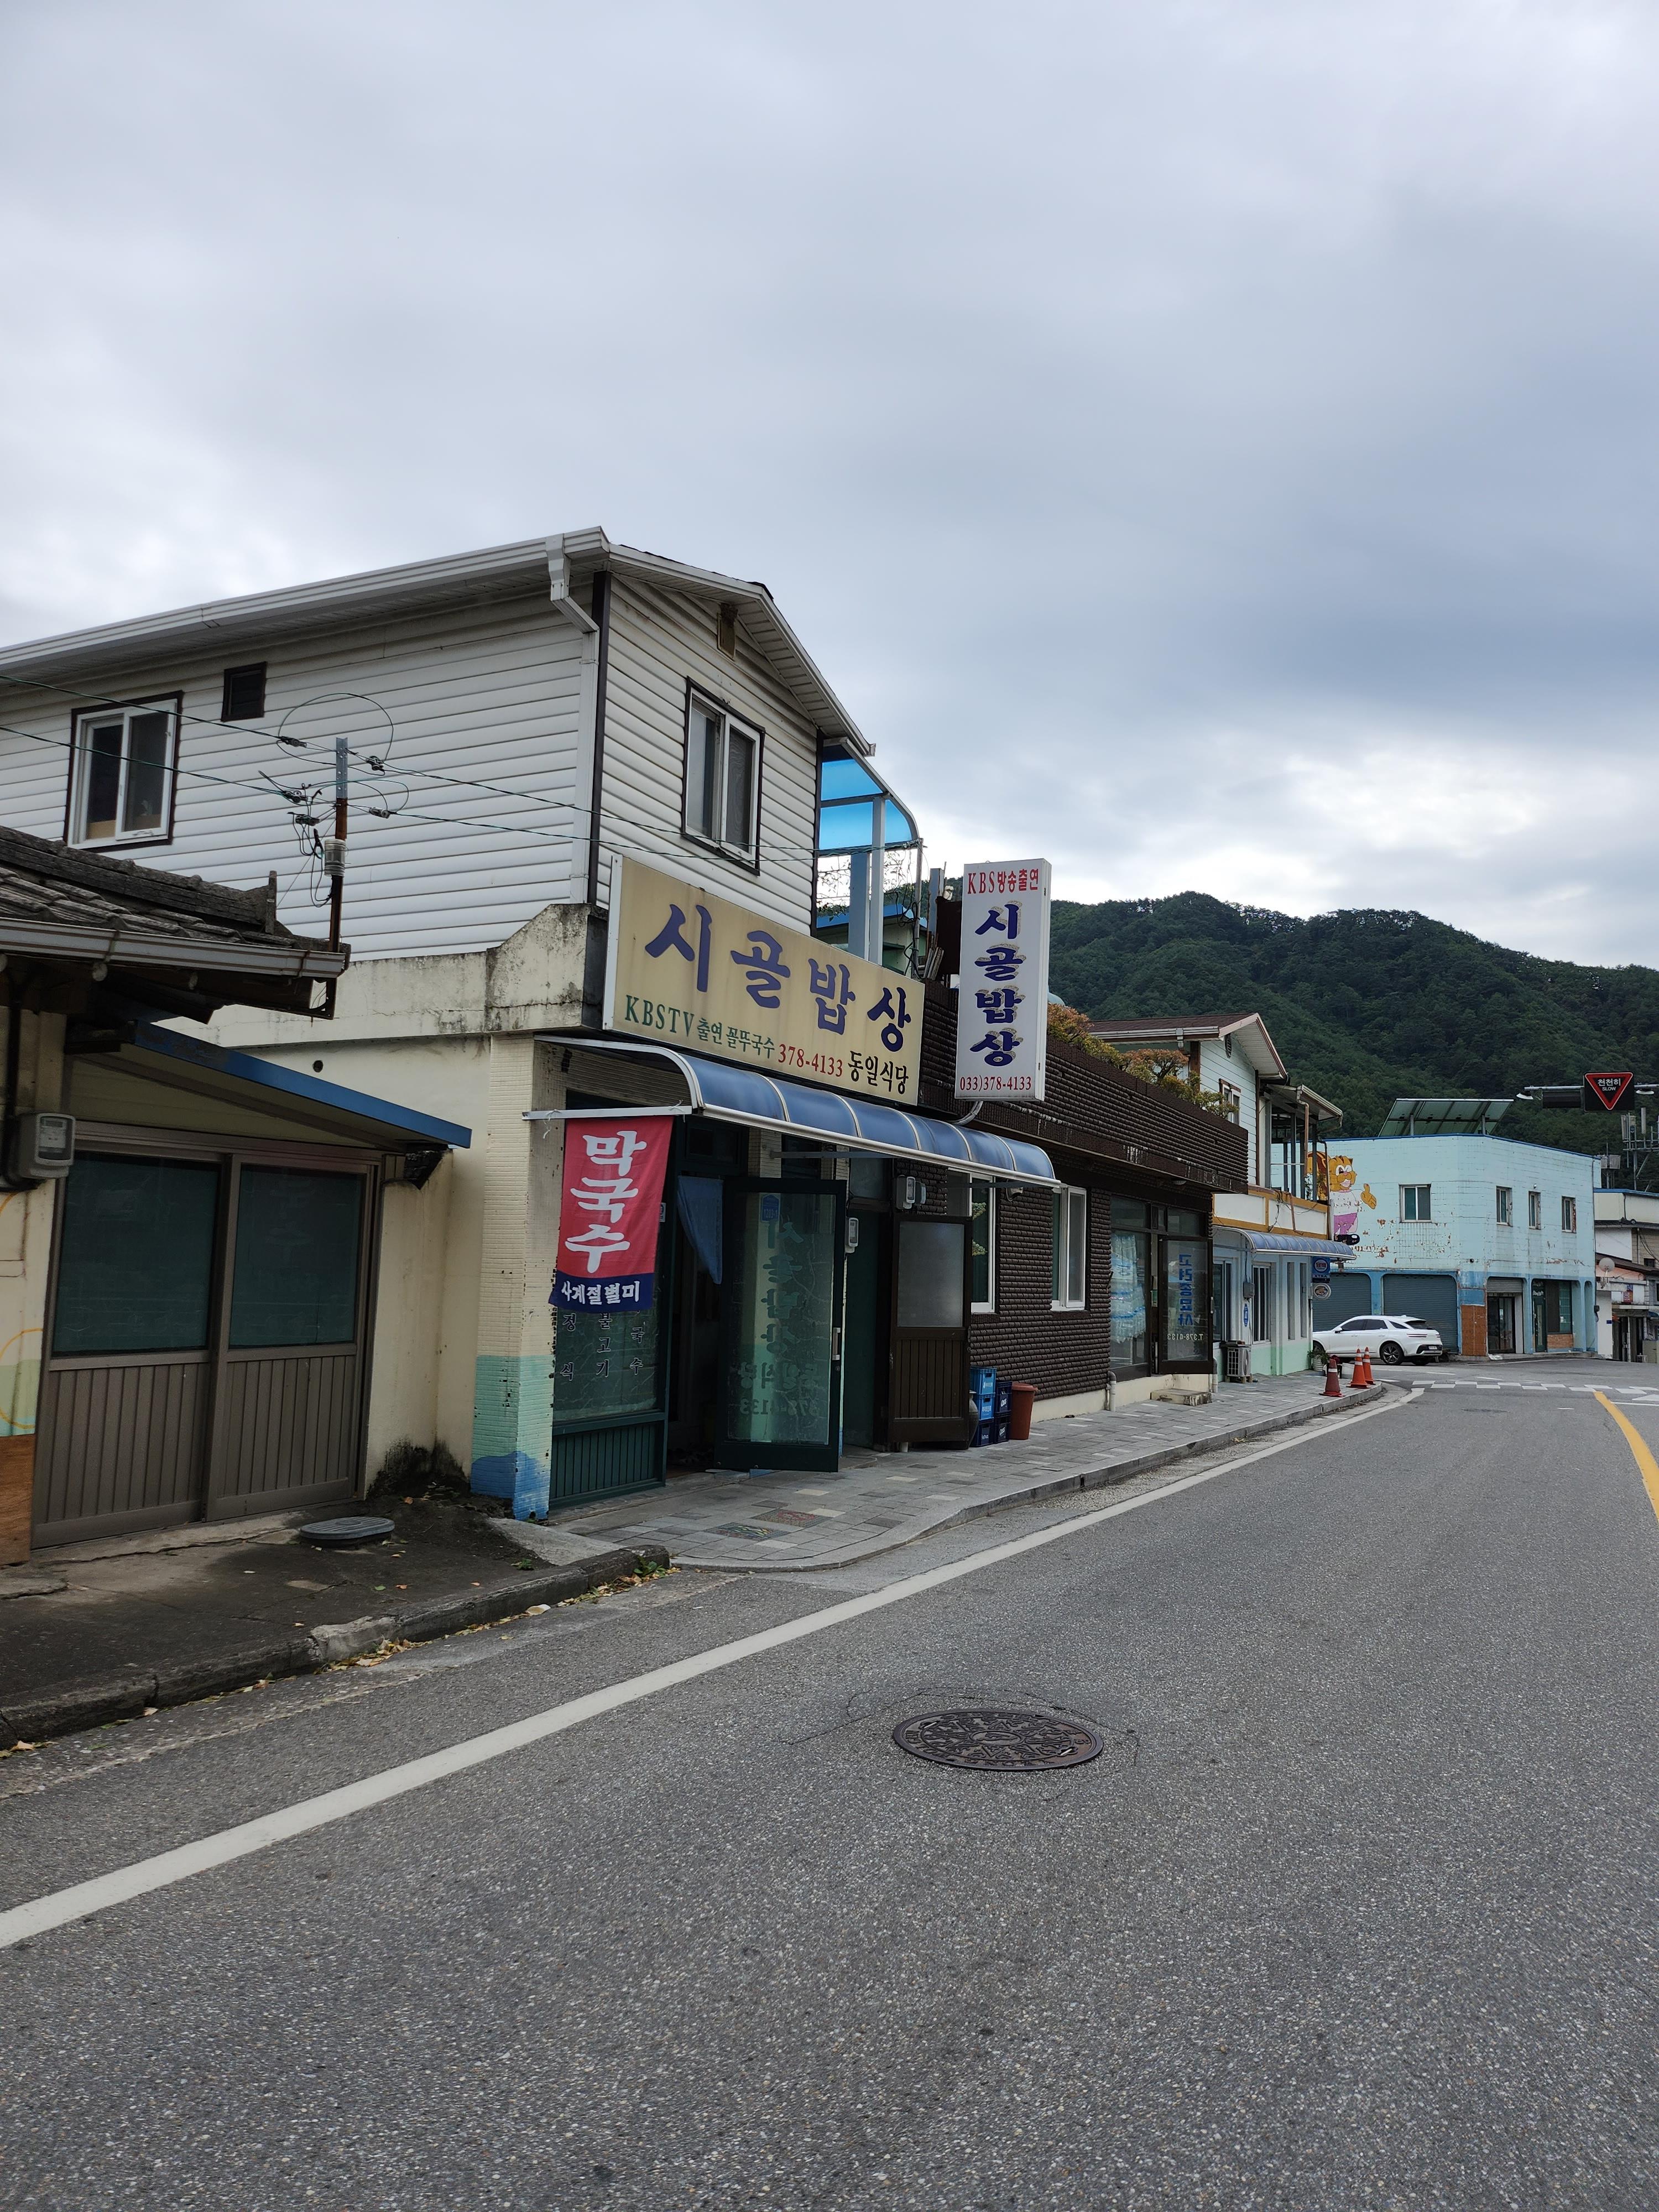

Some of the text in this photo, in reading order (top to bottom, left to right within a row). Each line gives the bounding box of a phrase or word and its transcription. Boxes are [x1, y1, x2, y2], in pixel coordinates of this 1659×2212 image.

[645, 904, 911, 1052] 시골밥상
[969, 900, 1026, 1067] 시골밥상
[726, 1026, 775, 1059] 꼴뚜국수
[778, 1044, 843, 1077] 378-4133
[848, 1051, 909, 1094] 동일식당
[959, 1074, 1032, 1092] 033)378-4133
[1598, 1078, 1621, 1087] 천천히
[565, 1130, 647, 1273] 막국수
[561, 1281, 640, 1305] 사계절별미
[596, 1313, 613, 1378] 불고기
[629, 1310, 645, 1375] 국수
